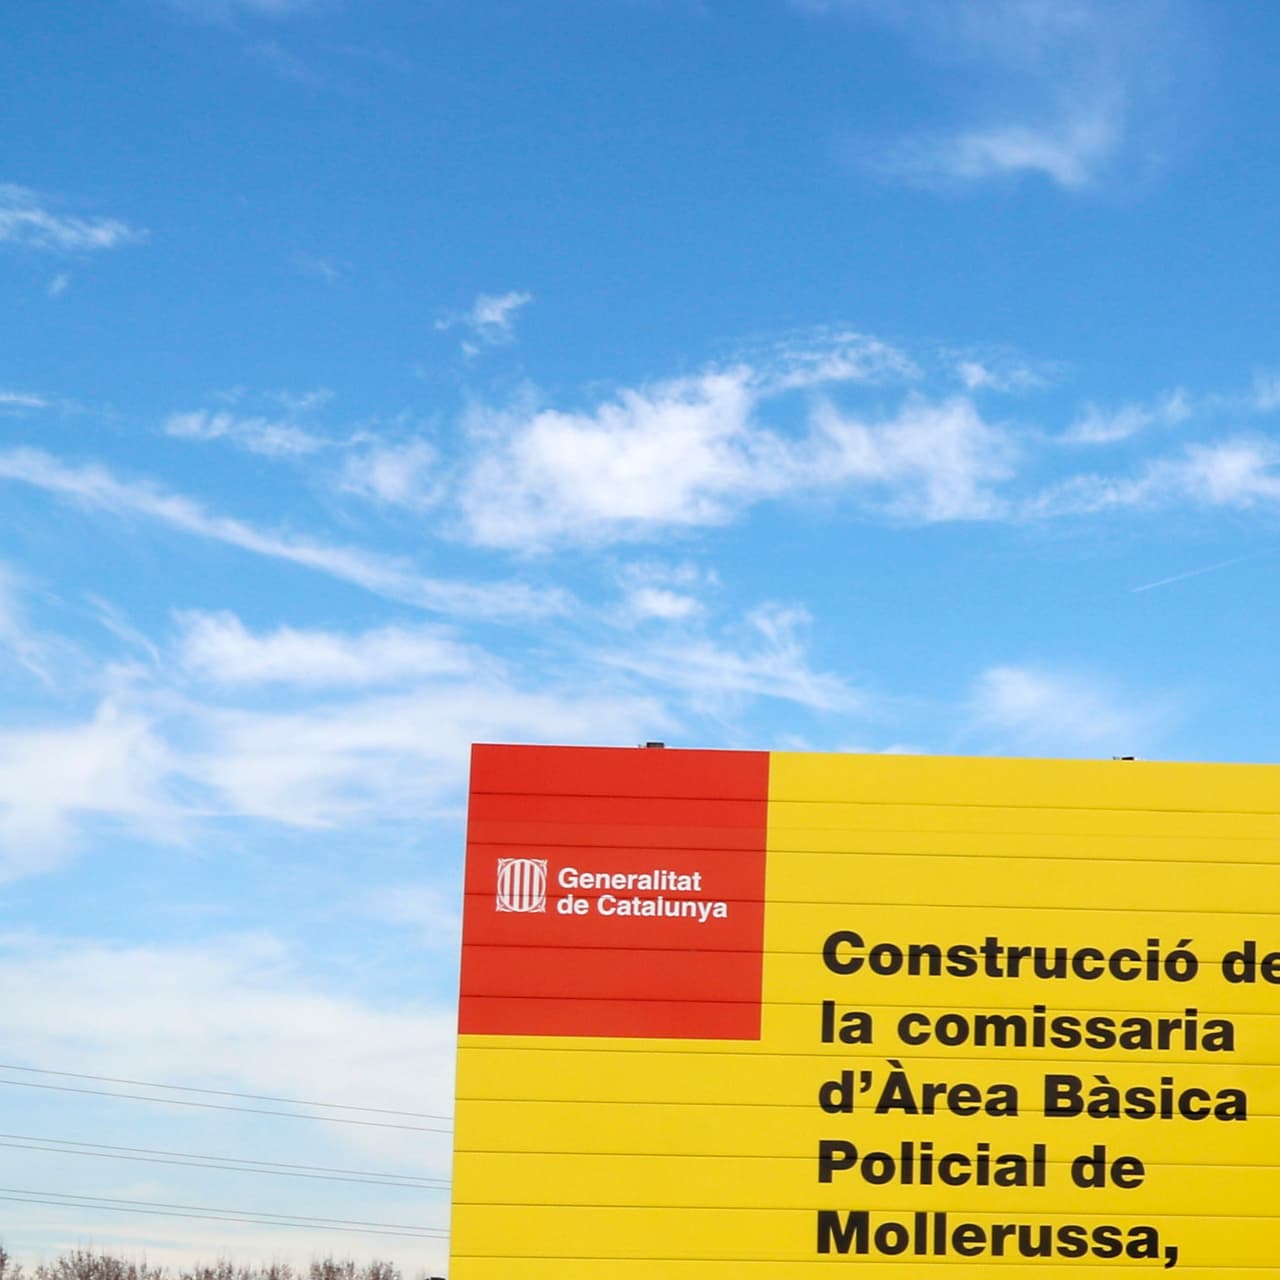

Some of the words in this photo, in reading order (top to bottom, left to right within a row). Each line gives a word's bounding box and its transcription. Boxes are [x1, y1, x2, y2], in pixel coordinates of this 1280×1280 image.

[558, 867, 702, 891] Generalitat
[557, 894, 589, 915] de
[597, 895, 728, 923] Catalunya
[822, 931, 1198, 983] Construcció
[821, 1001, 873, 1044] la
[897, 1004, 1236, 1052] comissaria
[1044, 1074, 1249, 1121] Bàsica
[817, 1140, 1047, 1188] Policial
[1070, 1145, 1146, 1189] de
[815, 1210, 1179, 1268] Mollerussa,
